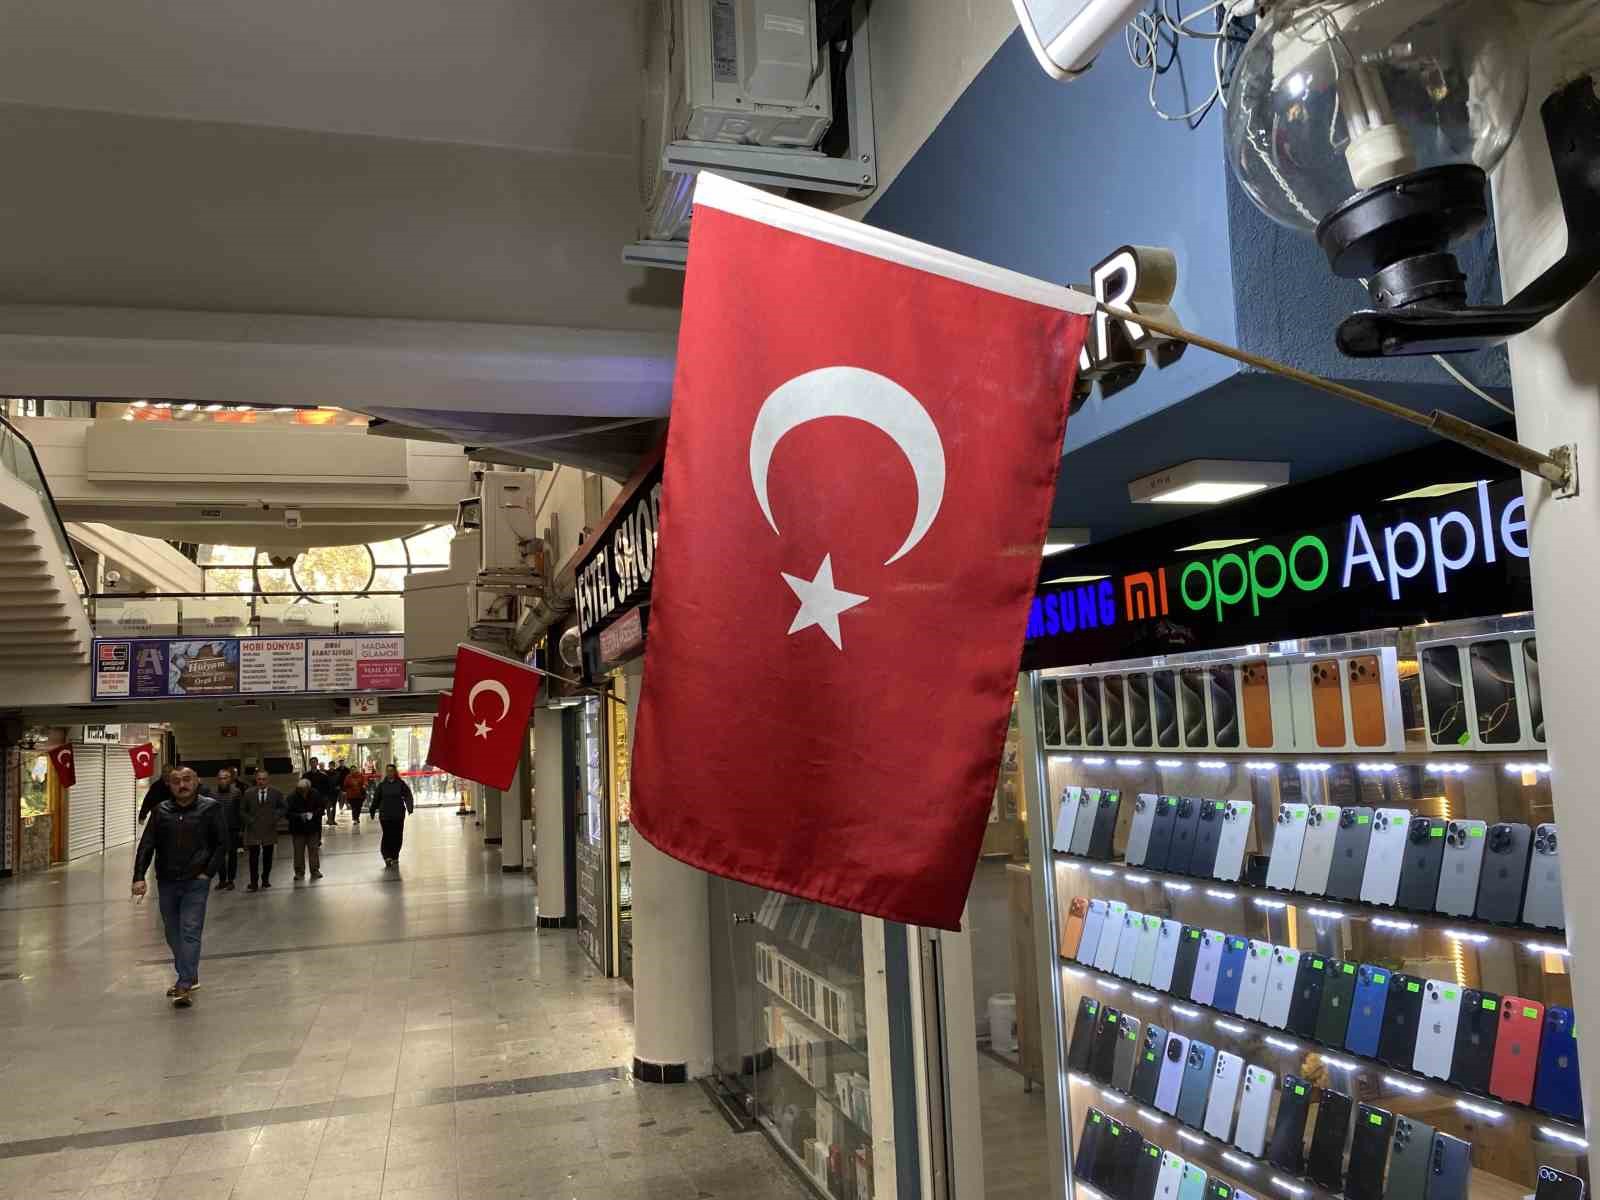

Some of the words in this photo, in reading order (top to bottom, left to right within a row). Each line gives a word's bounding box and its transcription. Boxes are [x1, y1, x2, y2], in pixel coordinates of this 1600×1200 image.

[1079, 247, 1146, 371] R
[1025, 580, 1116, 640] MSUNG
[1341, 479, 1531, 601] Apple
[361, 642, 399, 650] MADAME
[352, 696, 375, 706] WC
